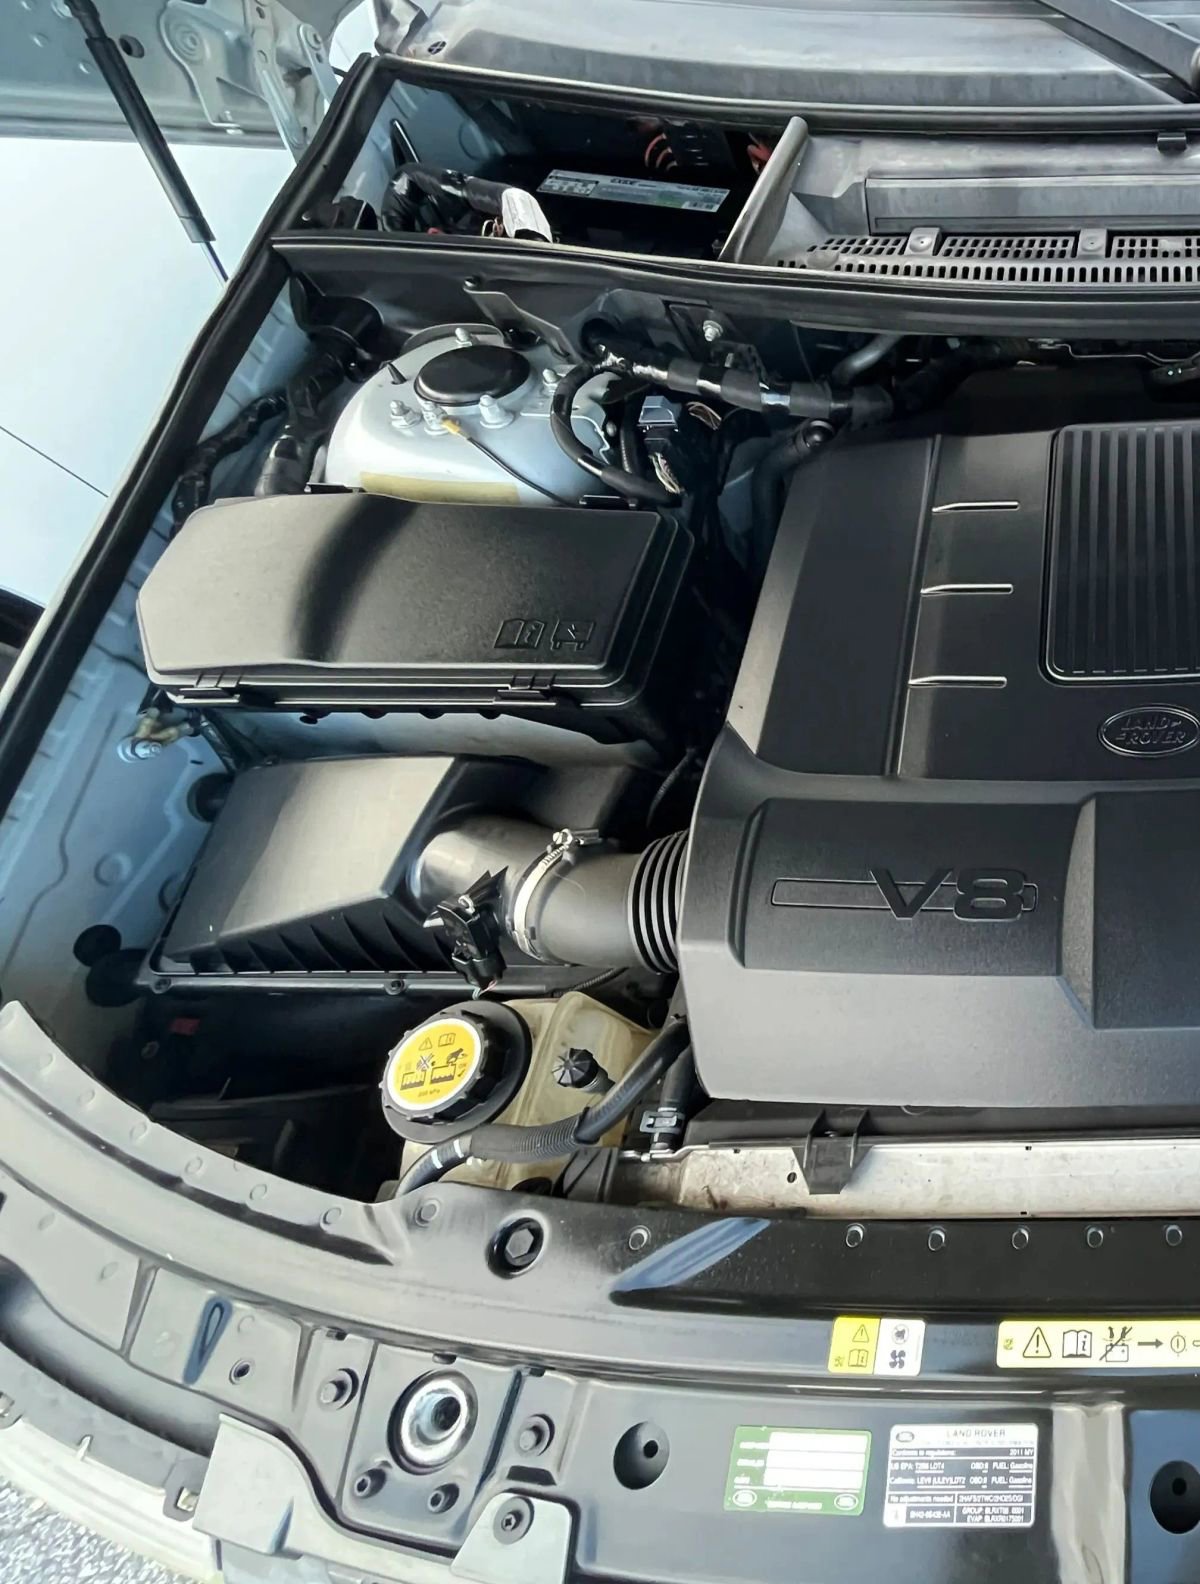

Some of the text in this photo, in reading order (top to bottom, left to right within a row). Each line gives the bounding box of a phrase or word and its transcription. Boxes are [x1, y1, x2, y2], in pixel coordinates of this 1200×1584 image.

[1121, 714, 1170, 731] LAND
[1125, 730, 1186, 745] ROVER
[869, 867, 1028, 923] V8
[947, 1429, 1006, 1438] LAND ROVER
[1009, 1448, 1023, 1456] 2011
